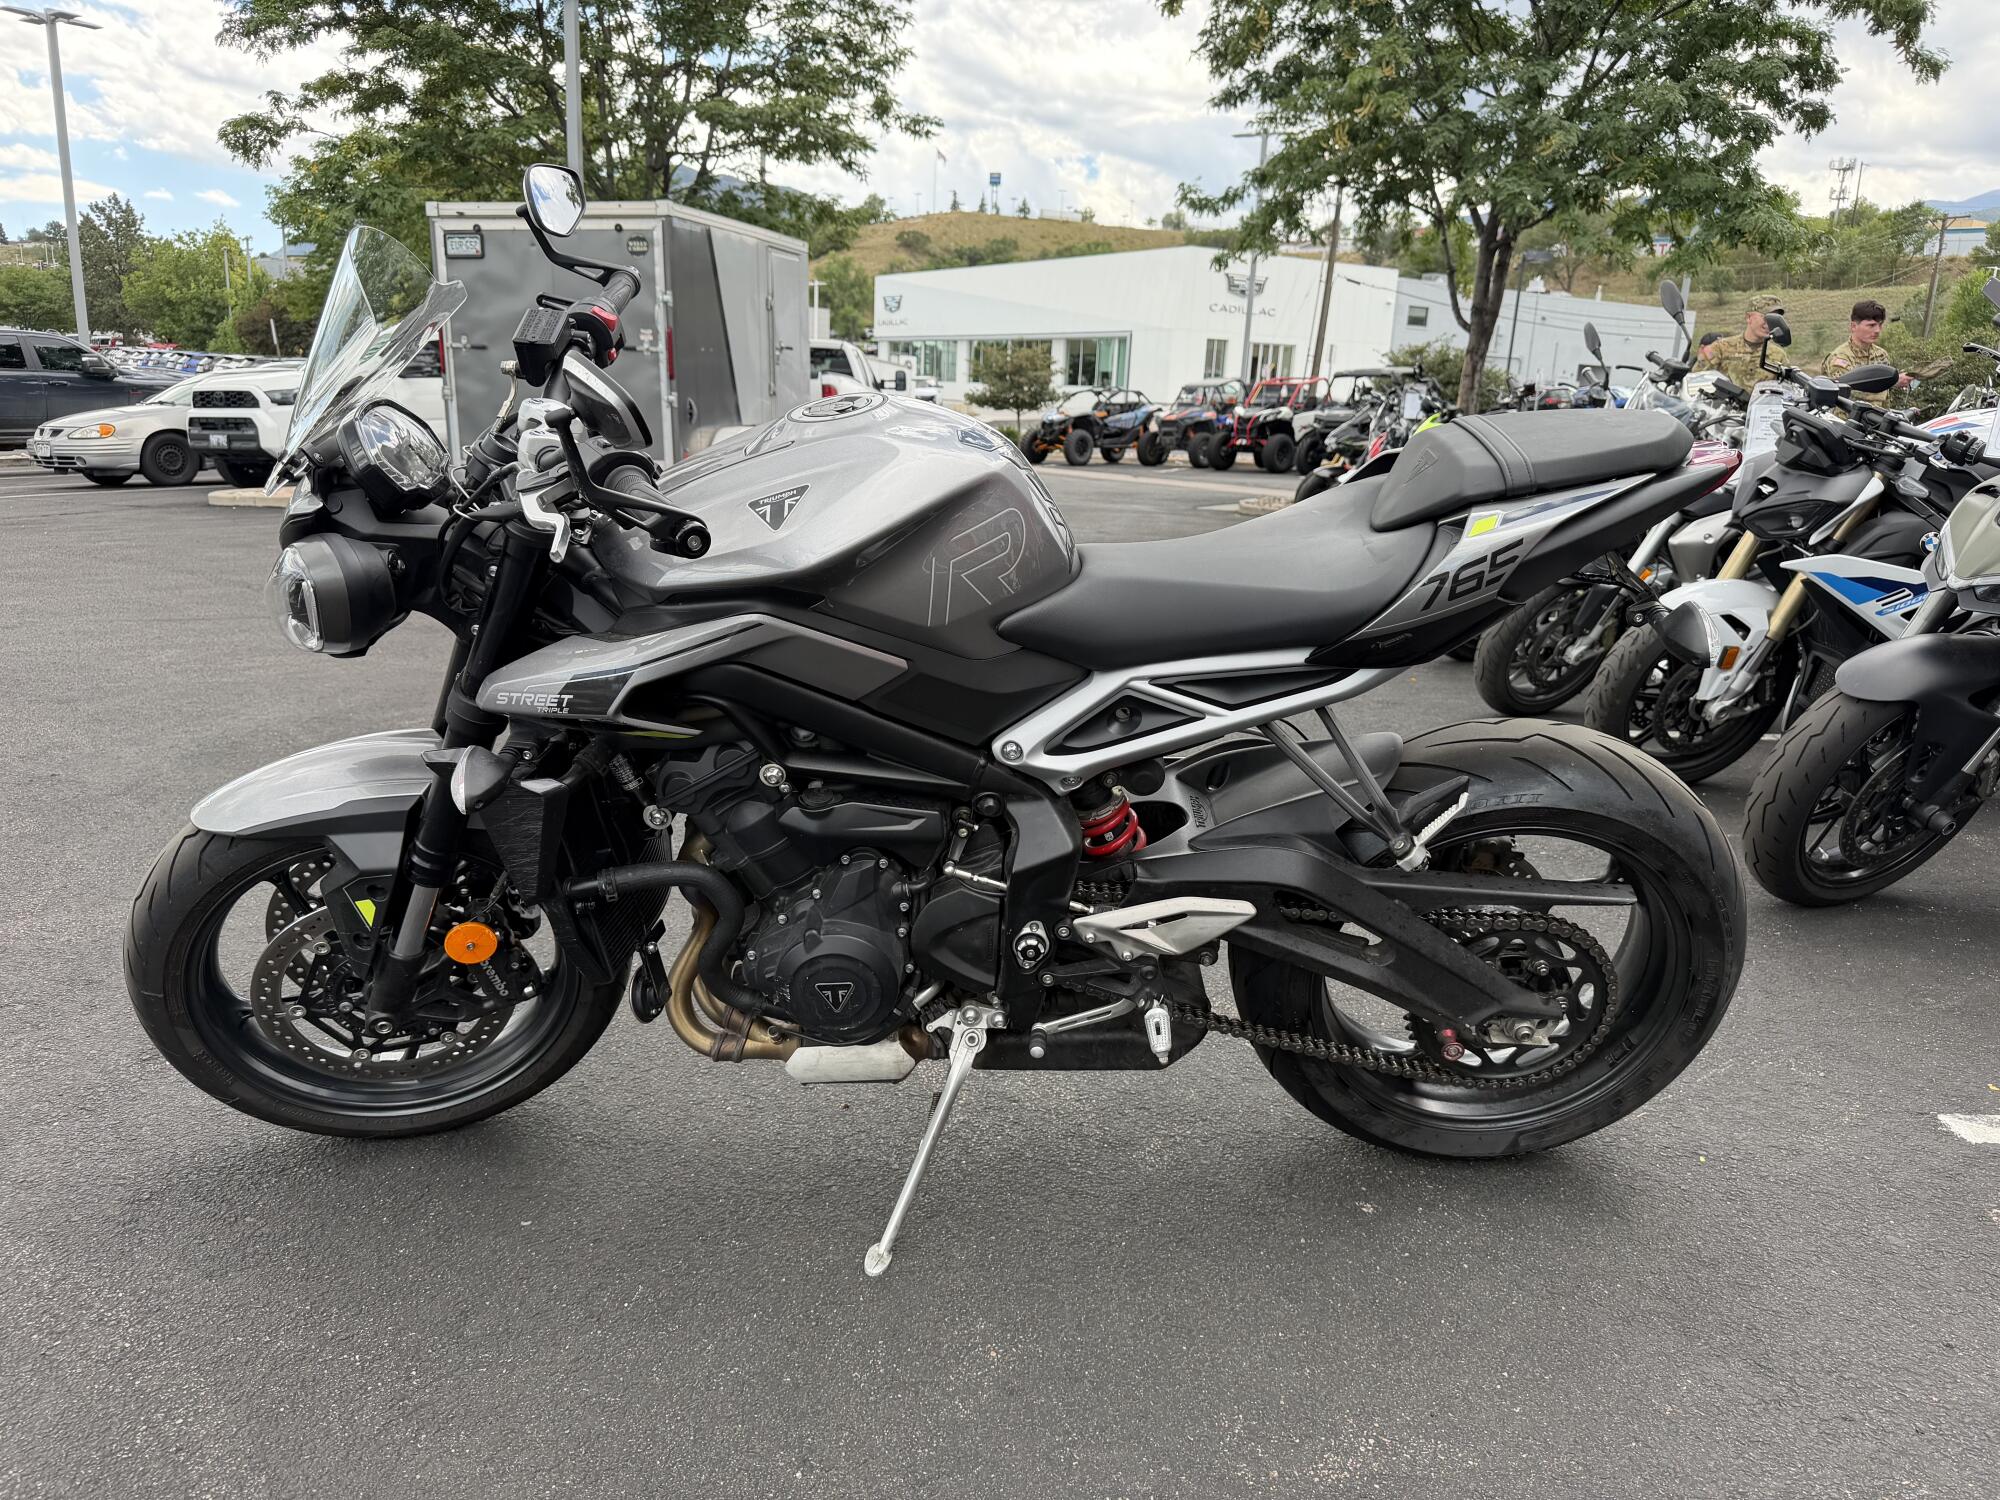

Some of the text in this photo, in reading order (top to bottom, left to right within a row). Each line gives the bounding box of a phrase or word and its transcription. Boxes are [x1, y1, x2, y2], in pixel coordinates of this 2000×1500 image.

[759, 489, 797, 505] TRIUMPH
[927, 507, 1026, 627] R
[1420, 537, 1524, 612] 765
[496, 692, 573, 707] STREET
[536, 706, 570, 714] TRIPLE
[1190, 795, 1208, 828] TRIUMPH
[480, 957, 509, 997] brembo
